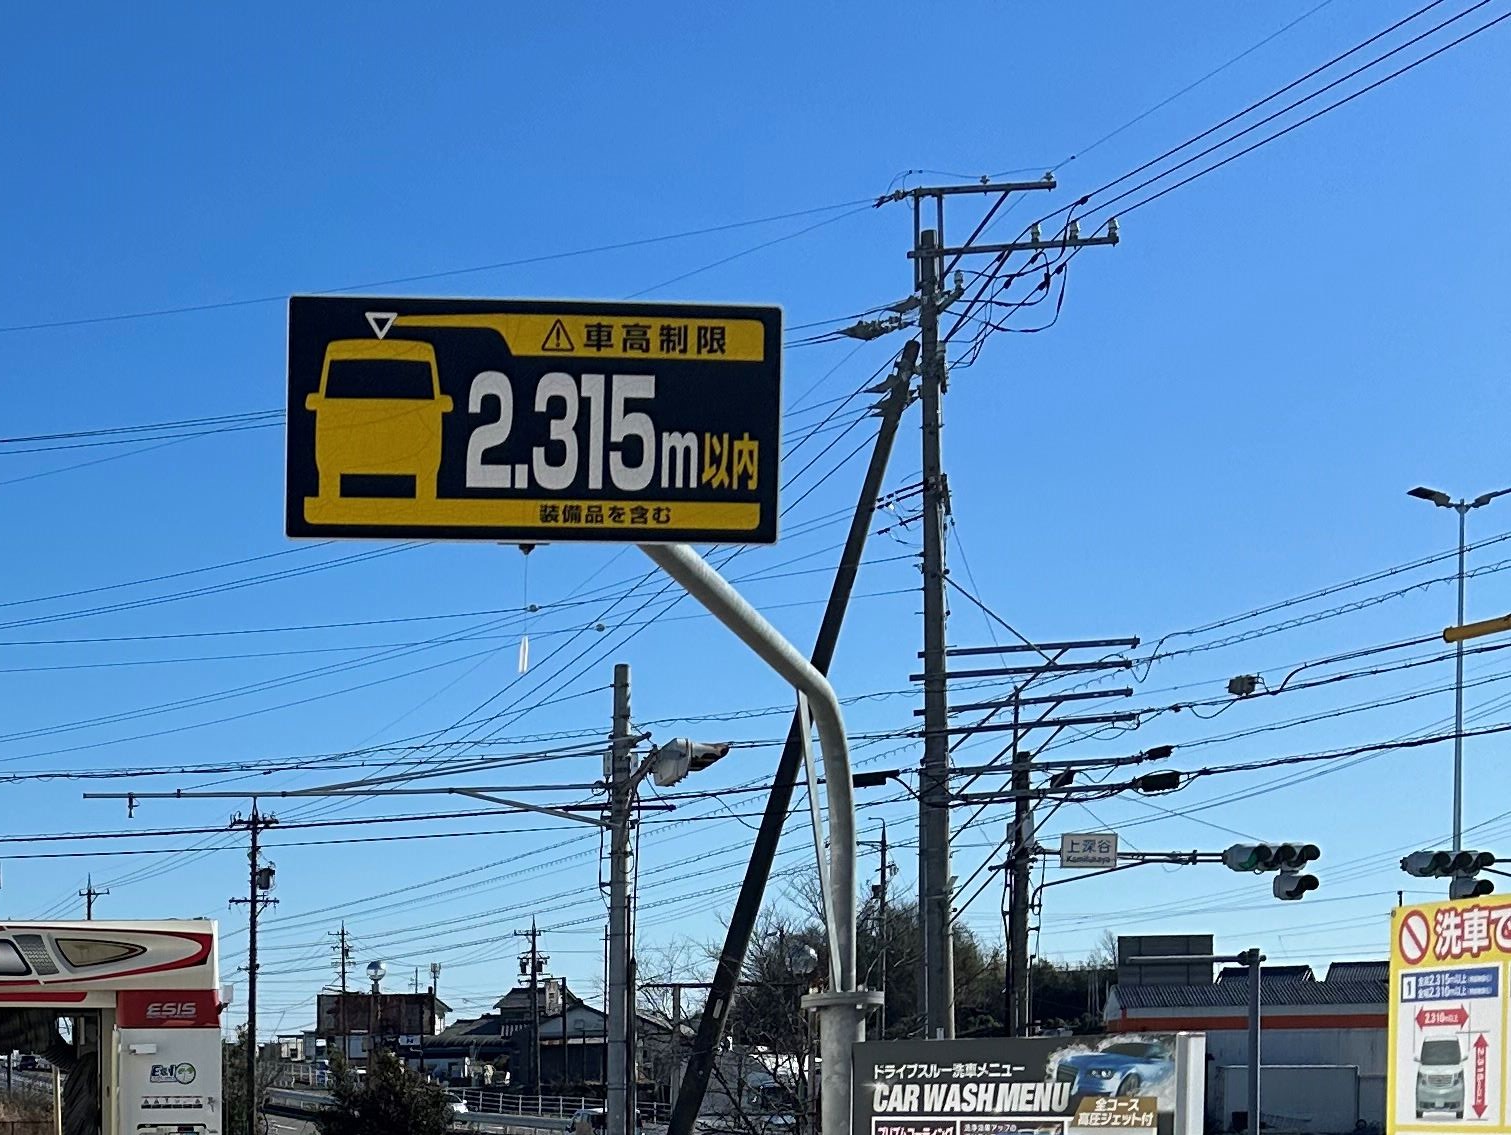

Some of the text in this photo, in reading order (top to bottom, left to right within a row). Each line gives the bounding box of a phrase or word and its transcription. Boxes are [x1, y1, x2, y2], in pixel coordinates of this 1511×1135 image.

[583, 321, 727, 356] 車高制限
[538, 504, 672, 526] 装備品を含む
[1067, 840, 1110, 853] 上深谷
[146, 1003, 197, 1016] ESIS
[873, 1062, 1026, 1080] ドライブスルー洗車メニュー
[873, 1082, 1071, 1113] CAR WASH MENU
[1094, 1097, 1140, 1112] 全コース
[1078, 1112, 1154, 1127] 高圧ジェット付
